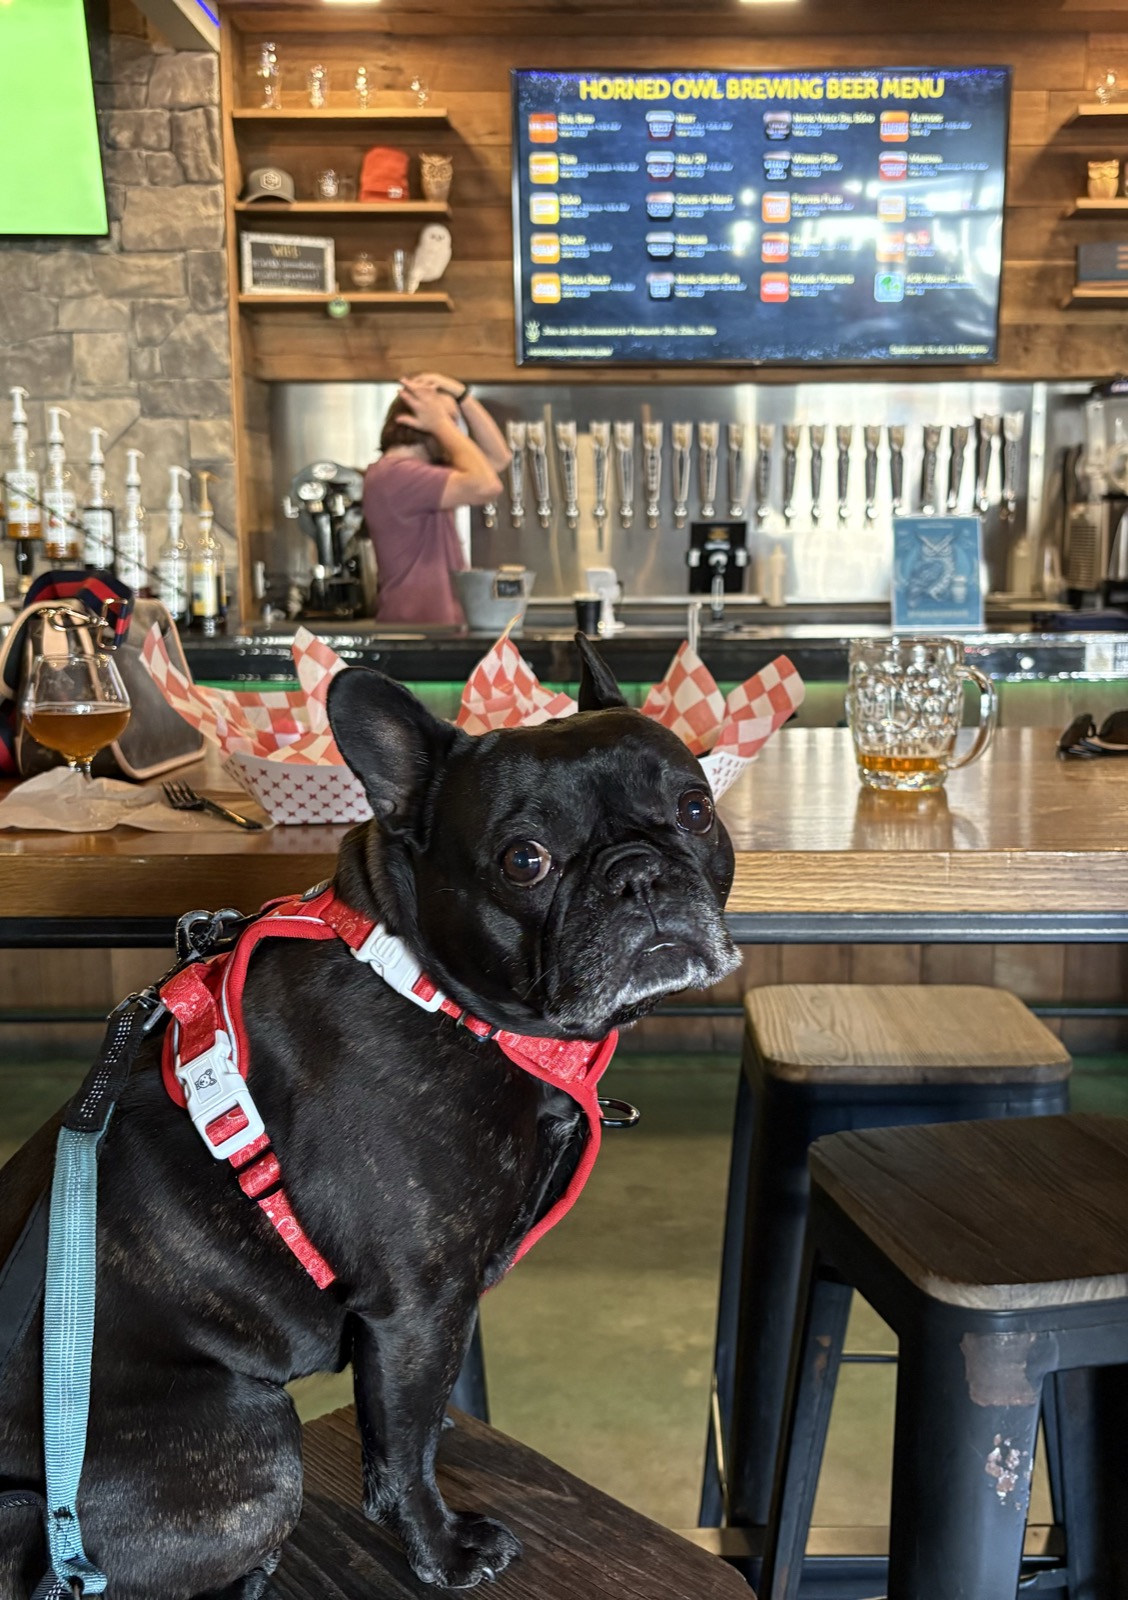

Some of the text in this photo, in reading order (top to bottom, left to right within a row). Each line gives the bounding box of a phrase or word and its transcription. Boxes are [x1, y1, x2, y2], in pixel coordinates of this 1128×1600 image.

[579, 78, 945, 100] HORNED OWL BREWING BEER MENU
